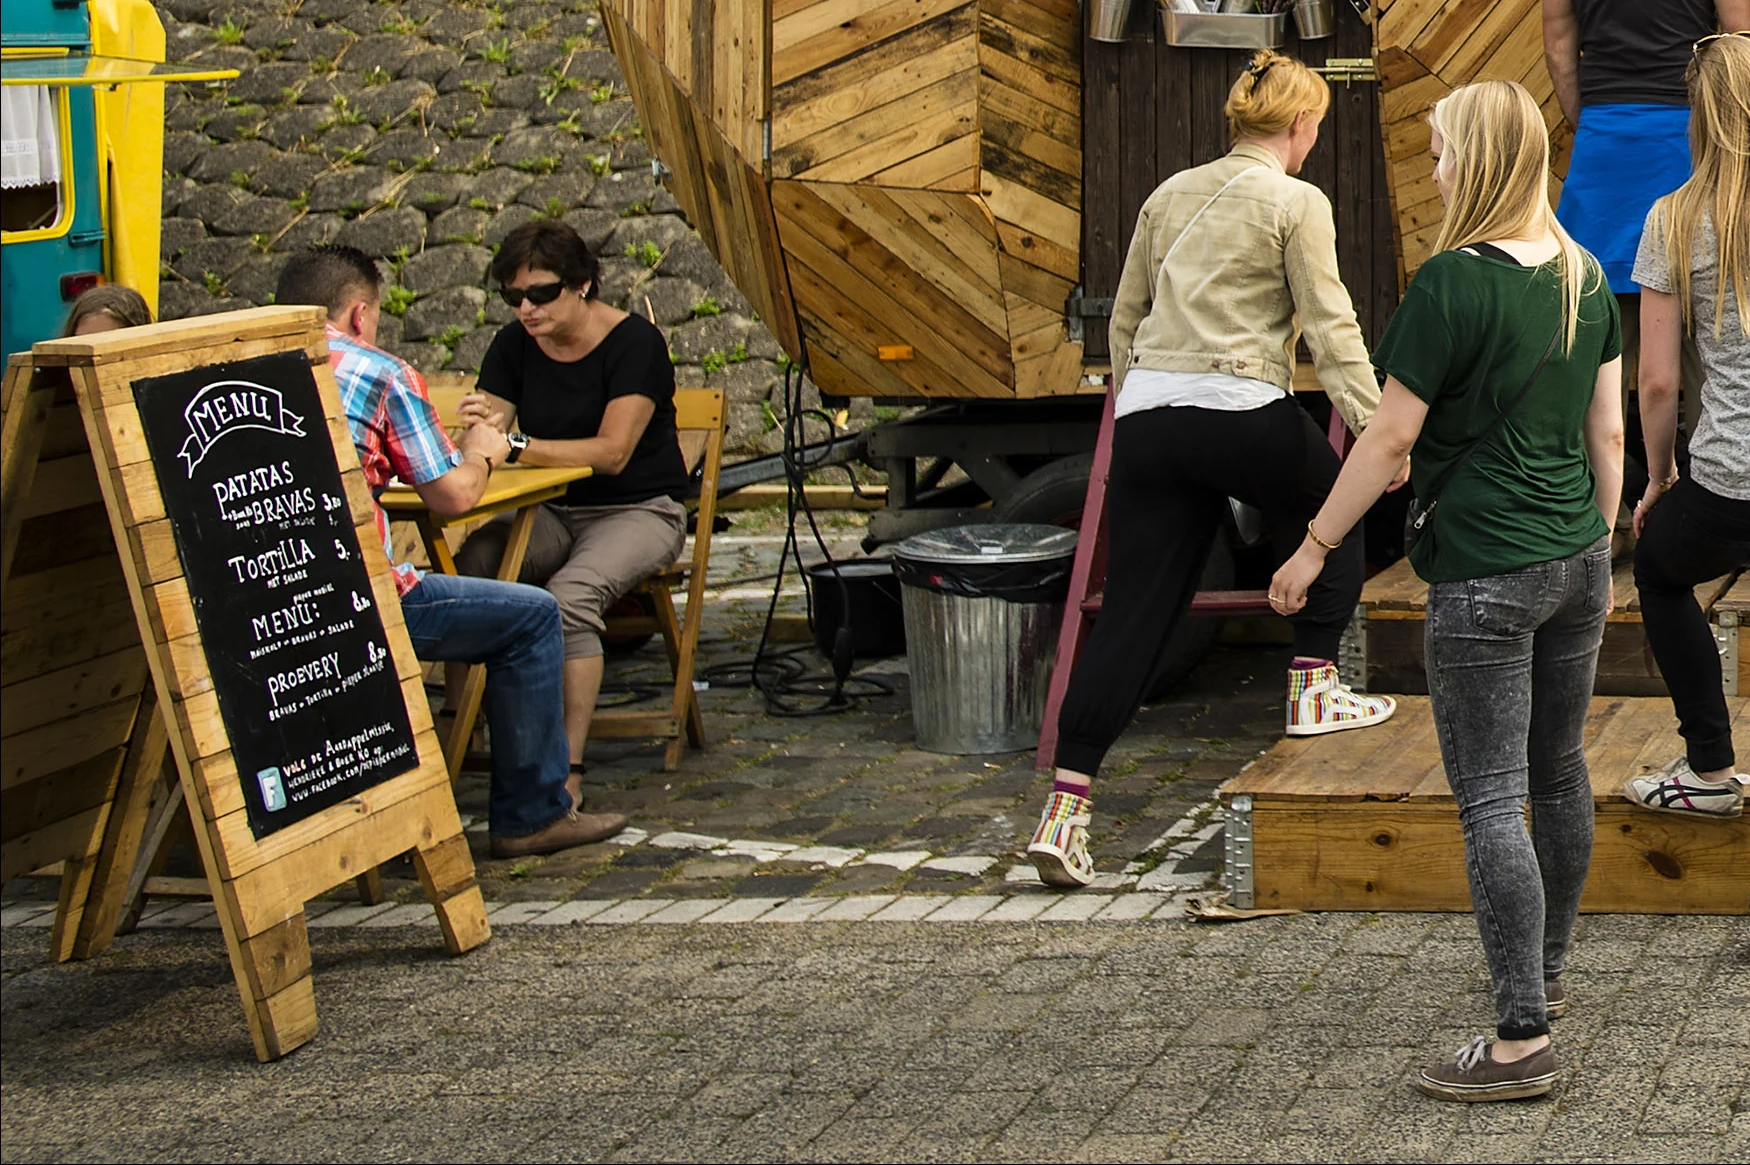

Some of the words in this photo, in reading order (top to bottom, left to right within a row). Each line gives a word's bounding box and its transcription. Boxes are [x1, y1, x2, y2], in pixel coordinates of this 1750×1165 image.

[192, 392, 272, 443] MENU
[213, 460, 294, 520] PATATAS
[253, 487, 316, 525] BRAVAS
[267, 575, 280, 588] MET
[283, 569, 308, 585] SALADE
[251, 602, 321, 642] MENU:
[327, 619, 355, 635] SALADE
[268, 652, 342, 707] PROEVERY
[268, 702, 298, 722] BRAVAS
